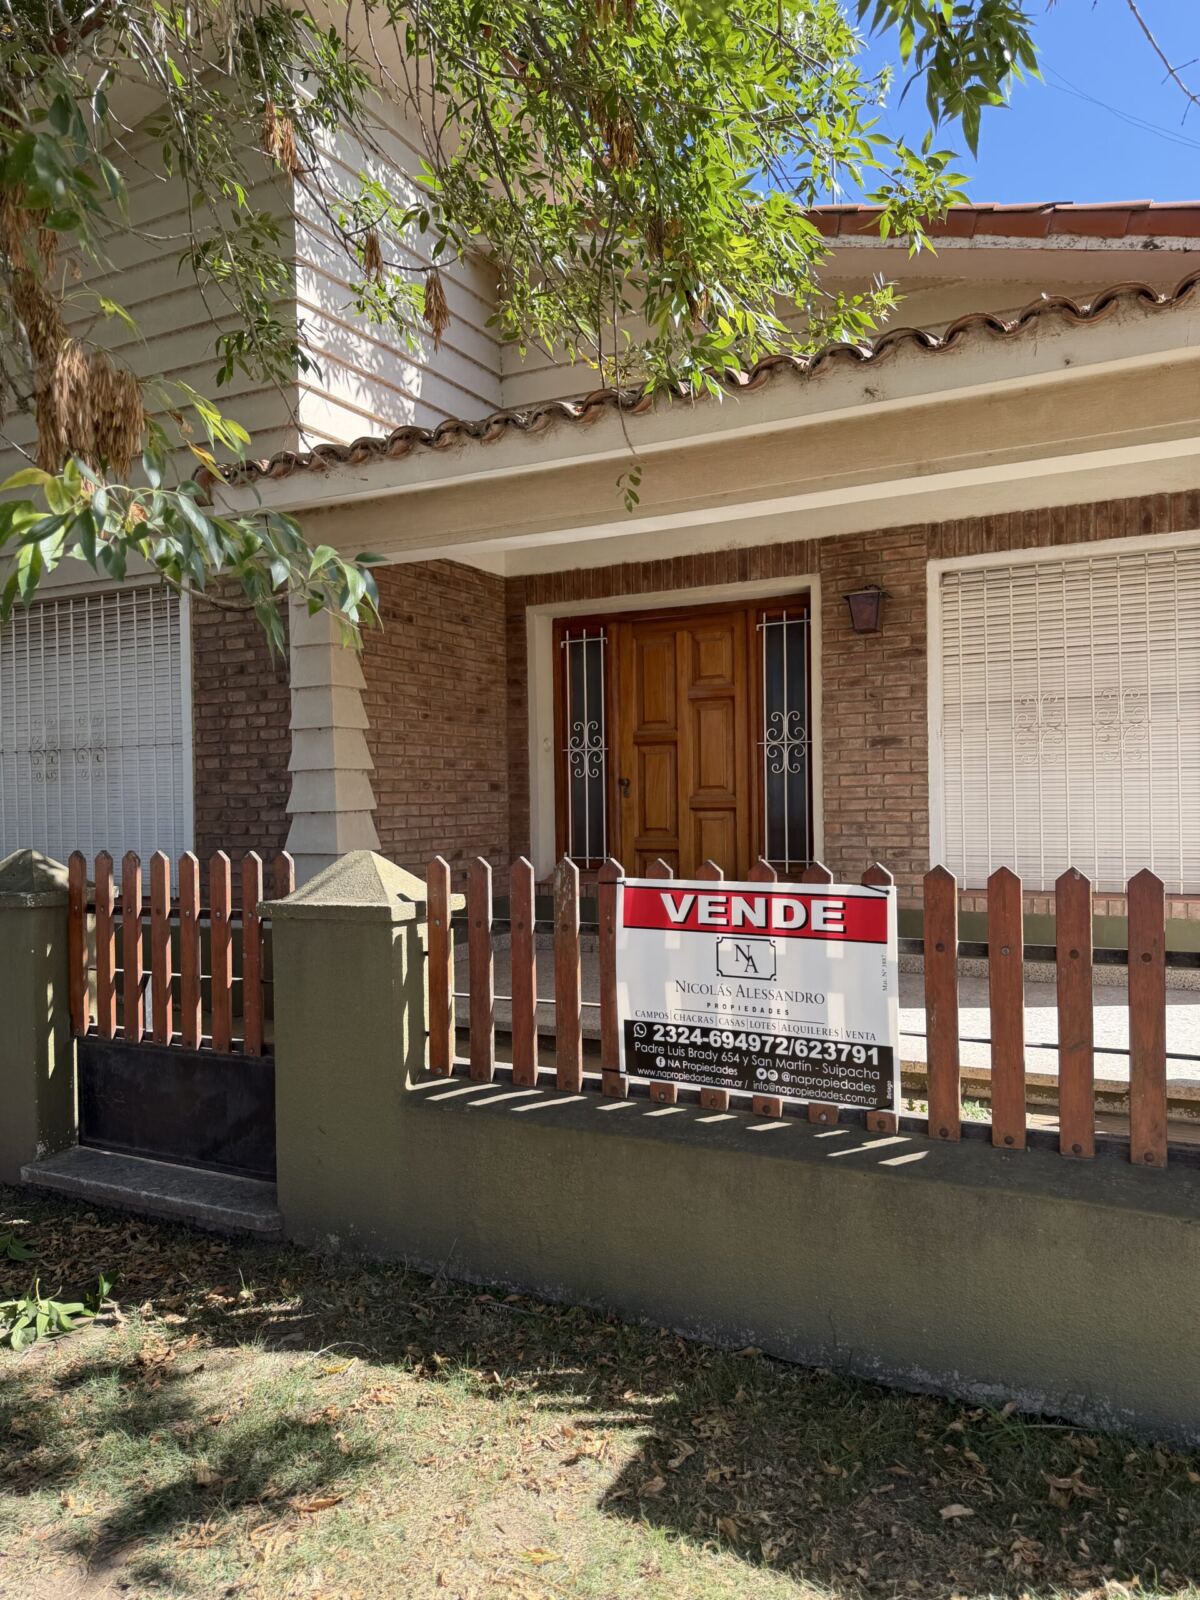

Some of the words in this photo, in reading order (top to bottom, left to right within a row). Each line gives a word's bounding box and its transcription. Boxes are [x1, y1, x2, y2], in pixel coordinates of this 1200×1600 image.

[660, 893, 847, 933] VENDE
[706, 1002, 789, 1016] PROPIEDADES
[735, 984, 825, 1005] ALESSANDRO
[635, 1009, 669, 1020] CAMPOS
[673, 1013, 714, 1025] CHACRAS
[718, 1017, 745, 1028] CASAS
[749, 1020, 777, 1031] LOTES
[780, 1023, 839, 1036] ALQUILERES
[845, 1030, 876, 1041] VENTA
[634, 1042, 665, 1055] Padre
[667, 1045, 686, 1057] Luis
[688, 1048, 718, 1063] Brady
[721, 1051, 739, 1063] 654
[742, 1056, 749, 1067] y
[751, 1055, 773, 1067] San
[822, 1063, 880, 1080] Suipacha
[652, 1024, 879, 1066] 2324-694972/623791
[667, 1059, 681, 1069] NA
[682, 1061, 738, 1076] Propiedades
[781, 1072, 876, 1093] @napropiedades
[637, 1067, 743, 1088] www.napropiedades.com.ar
[753, 1081, 878, 1105] info@napropiedades.com.ar
